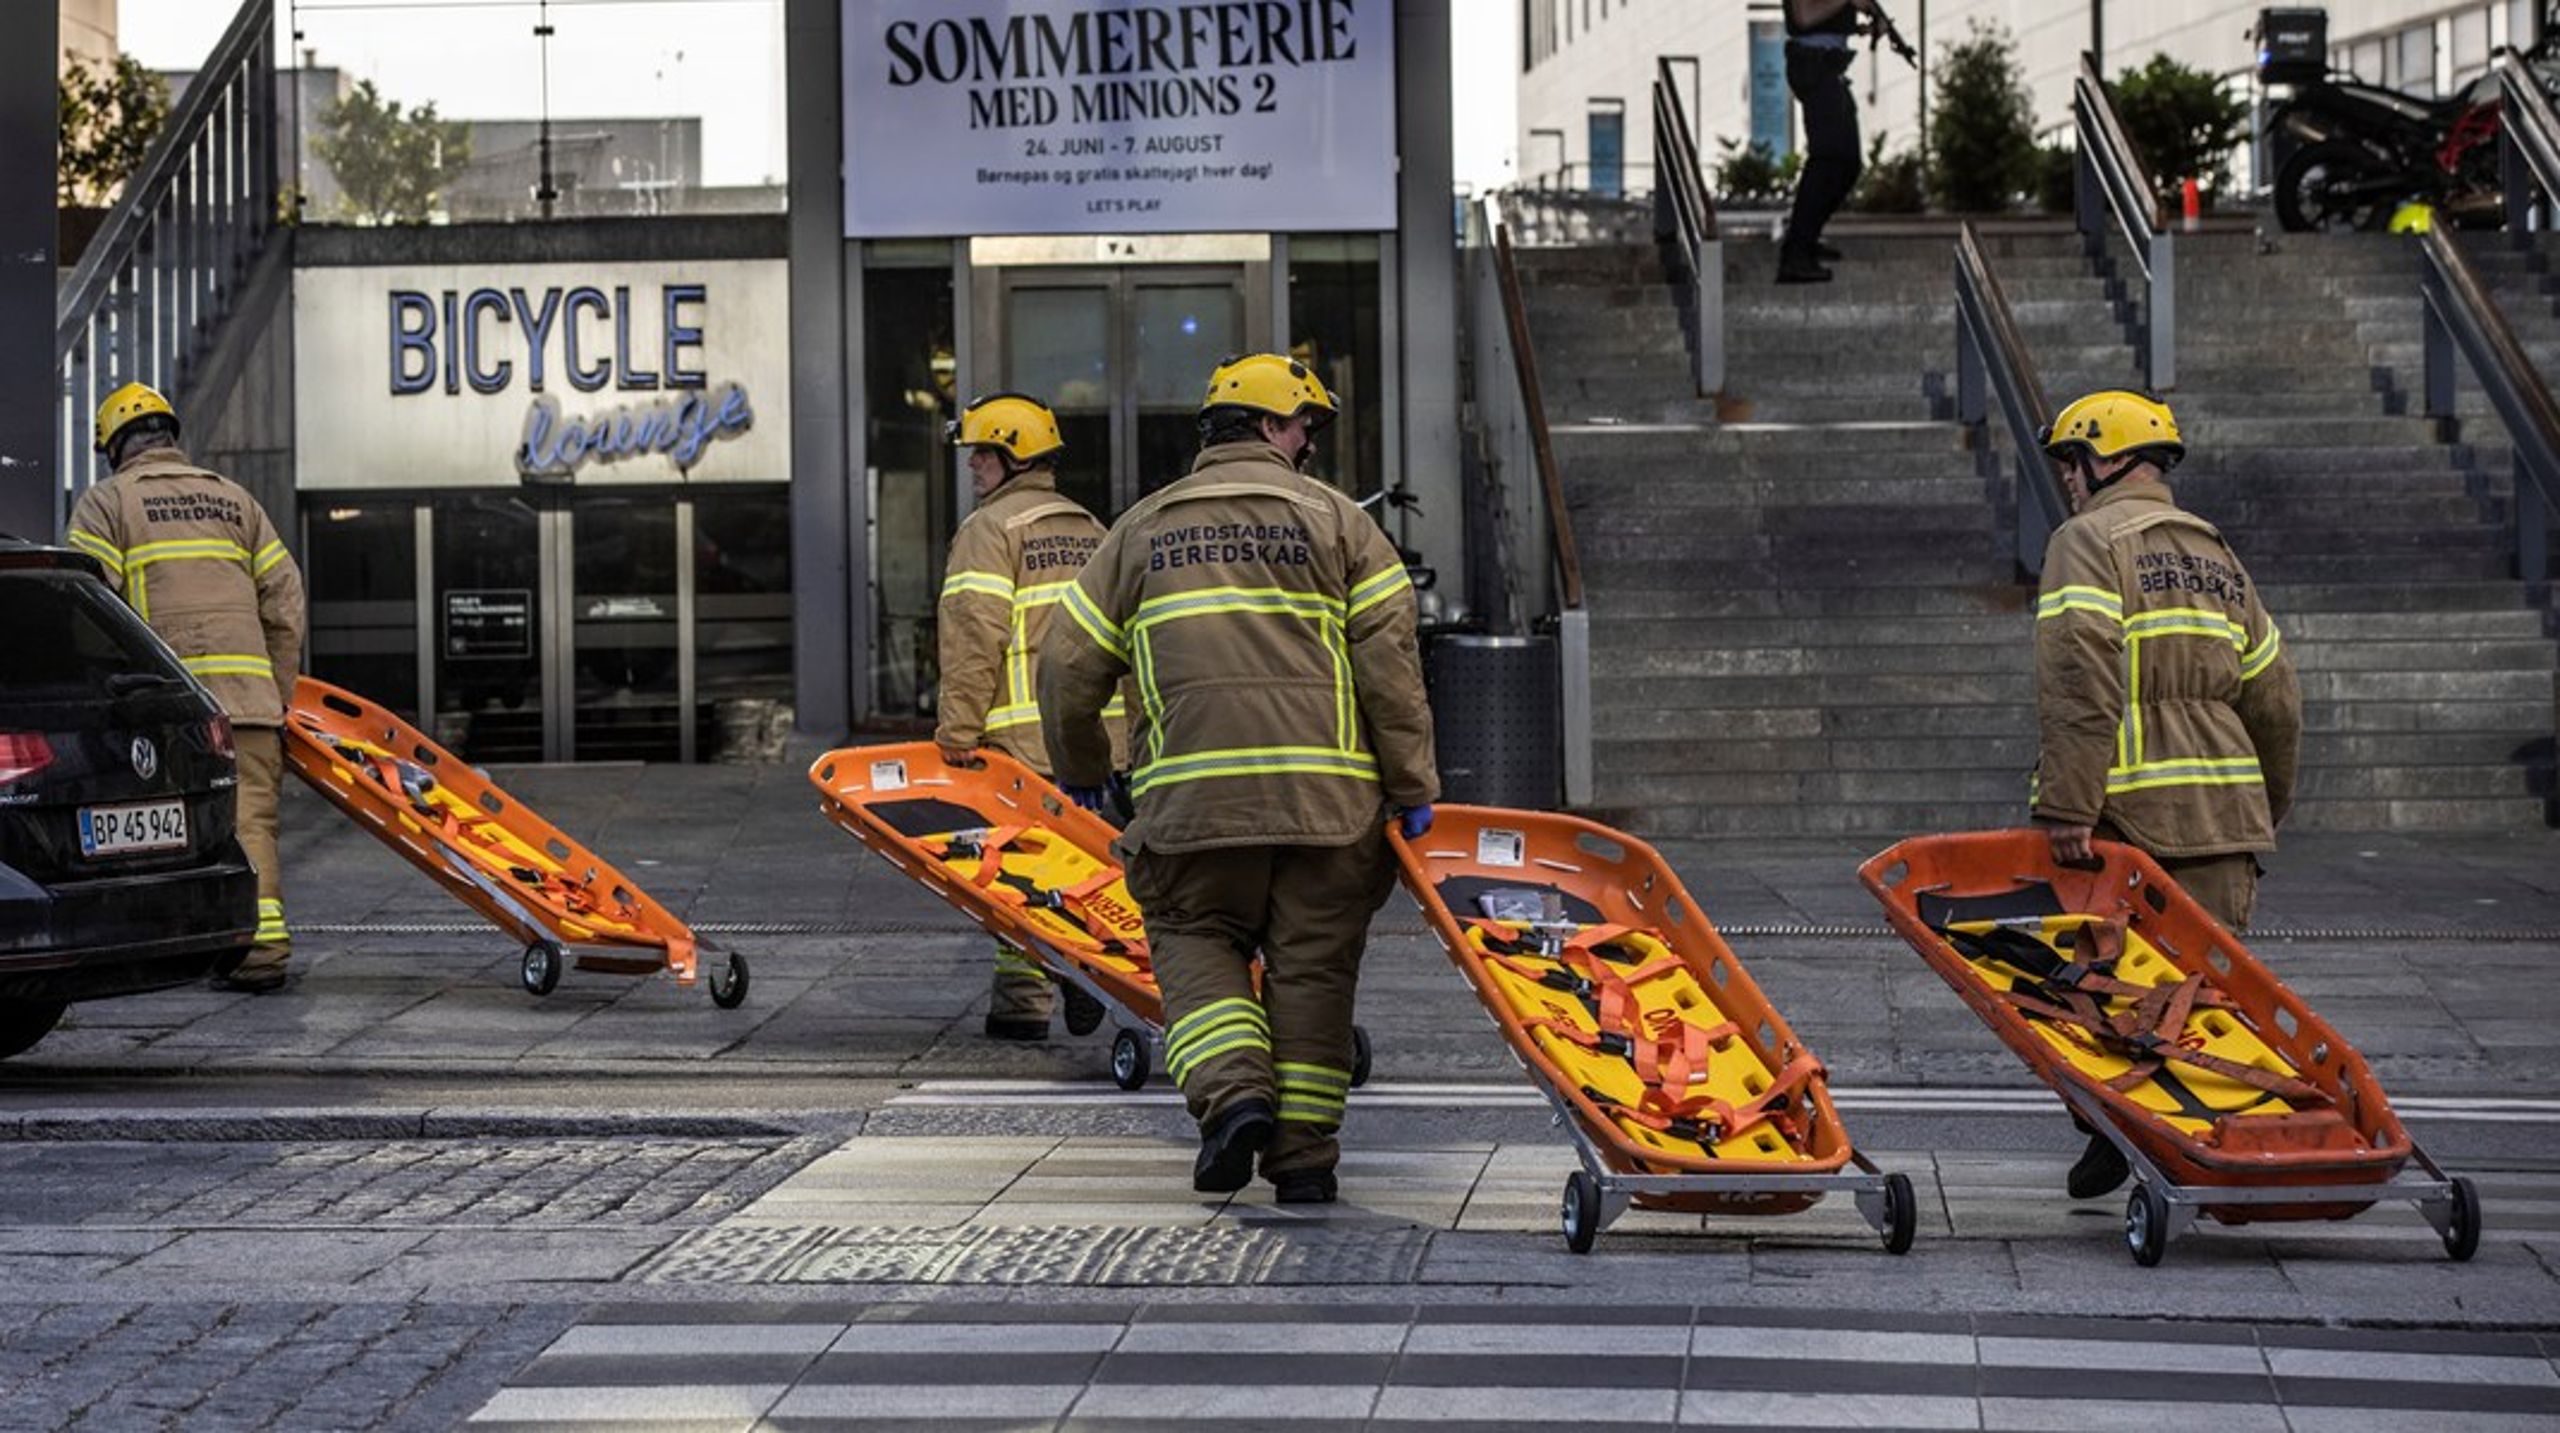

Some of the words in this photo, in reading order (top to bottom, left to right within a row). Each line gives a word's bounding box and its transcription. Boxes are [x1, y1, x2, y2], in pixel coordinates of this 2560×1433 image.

[884, 0, 1358, 87] SOMMERFERIE
[968, 86, 1058, 130] MED
[1072, 74, 1242, 124] MINIONS
[1252, 72, 1278, 114] 2
[1025, 138, 1051, 156] 24.
[1059, 138, 1104, 155] JUNI
[1124, 137, 1138, 154] 7.
[1145, 134, 1225, 154] AUGUST
[976, 168, 1049, 185] Børnepas
[1053, 170, 1072, 185] og
[1076, 167, 1121, 184] gratis
[1124, 165, 1198, 183] skattejagt
[1202, 163, 1235, 178] hver
[1240, 162, 1272, 181] dag!
[1087, 199, 1124, 213] LET'S
[1126, 199, 1161, 212] PLAY
[388, 283, 707, 396] BICYCLE
[516, 381, 753, 475] lounge
[1022, 536, 1099, 551] HOVEDSTADE
[1150, 523, 1310, 549] HOVEDSTADENS
[1026, 550, 1091, 570] BEREDS
[1151, 542, 1308, 571] BEREDSKAB
[94, 813, 119, 845] BP
[123, 810, 147, 842] 45
[150, 808, 184, 841] 942
